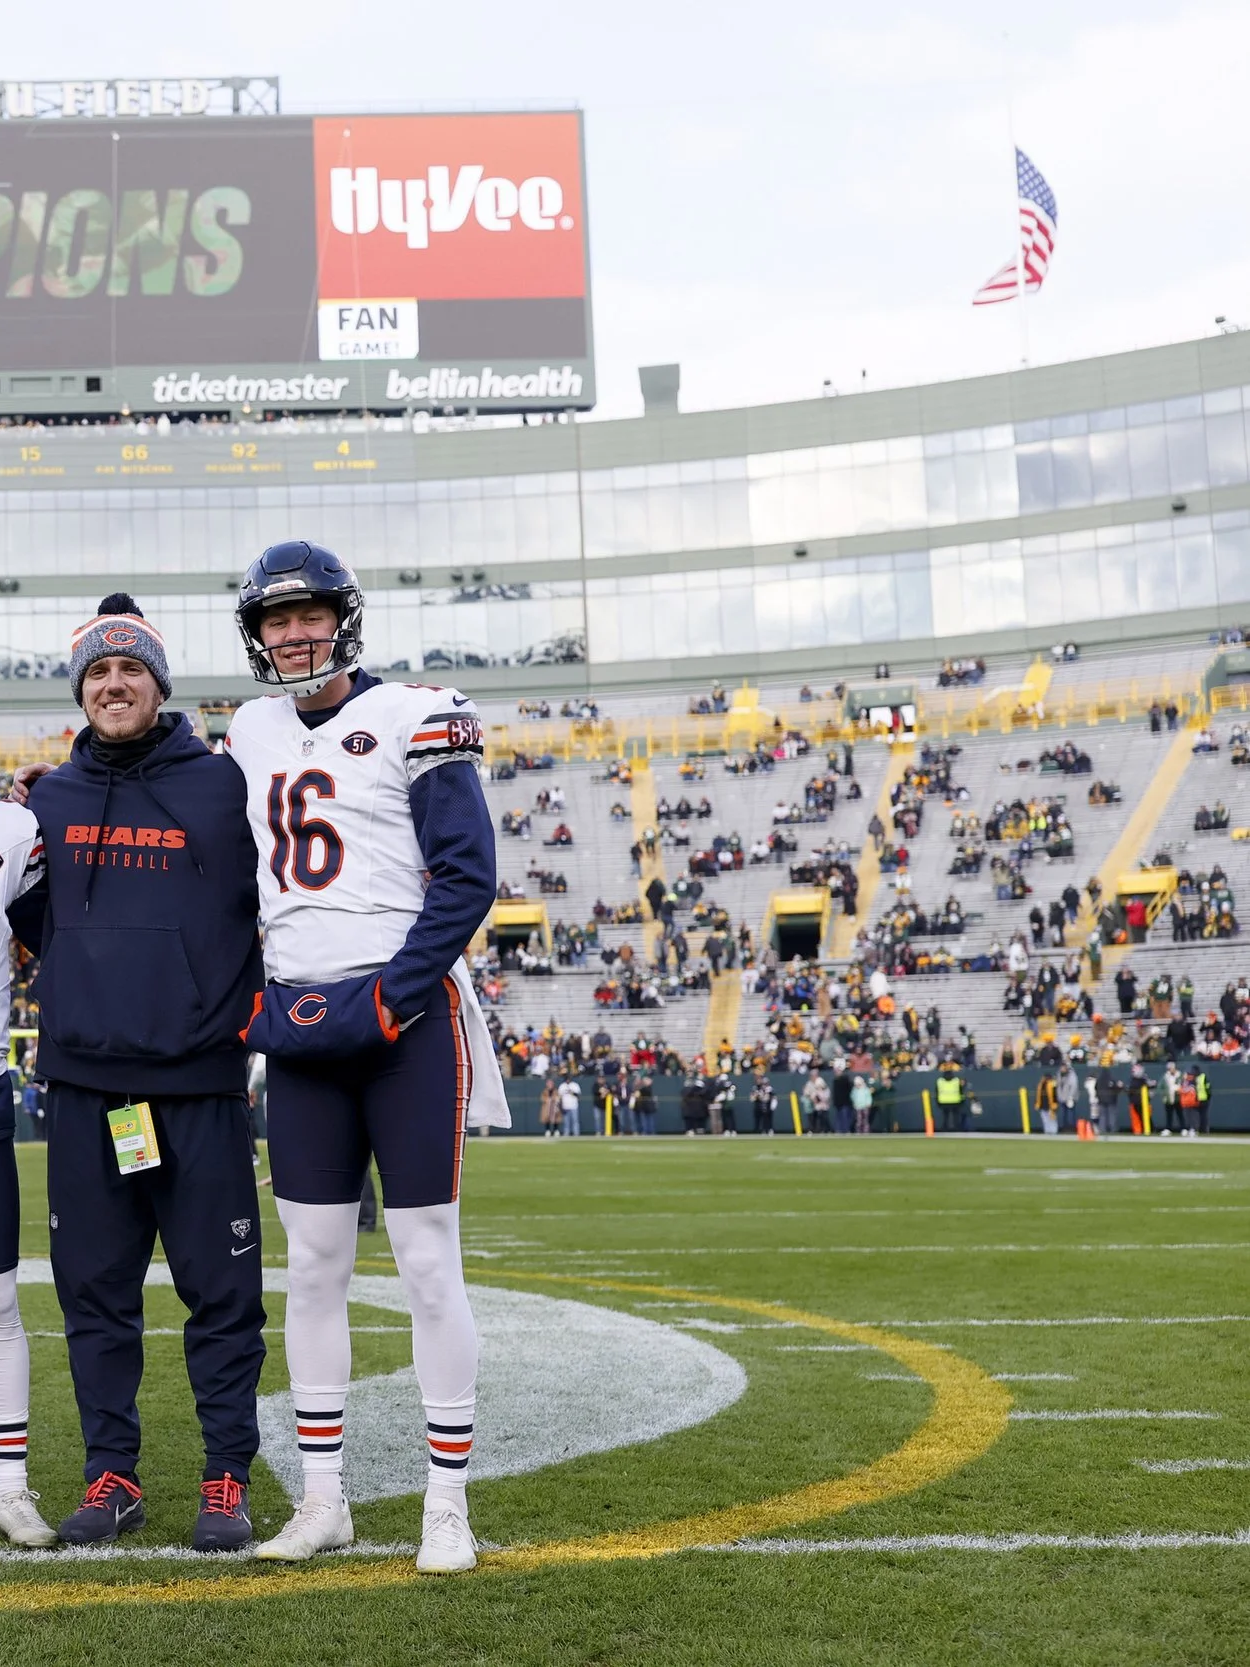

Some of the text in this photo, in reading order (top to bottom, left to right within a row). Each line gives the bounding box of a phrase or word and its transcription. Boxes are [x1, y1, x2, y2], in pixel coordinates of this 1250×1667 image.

[61, 79, 209, 117] FIELD
[338, 307, 398, 331] FAN
[151, 371, 350, 404] ticketmaster
[19, 446, 42, 462] 15
[121, 444, 149, 461] 66
[230, 442, 258, 459] 92
[335, 440, 351, 456] 4
[352, 738, 365, 753] 51
[64, 824, 187, 849] BEARS
[267, 768, 345, 894] 16
[73, 849, 170, 871] FOOTBALL
